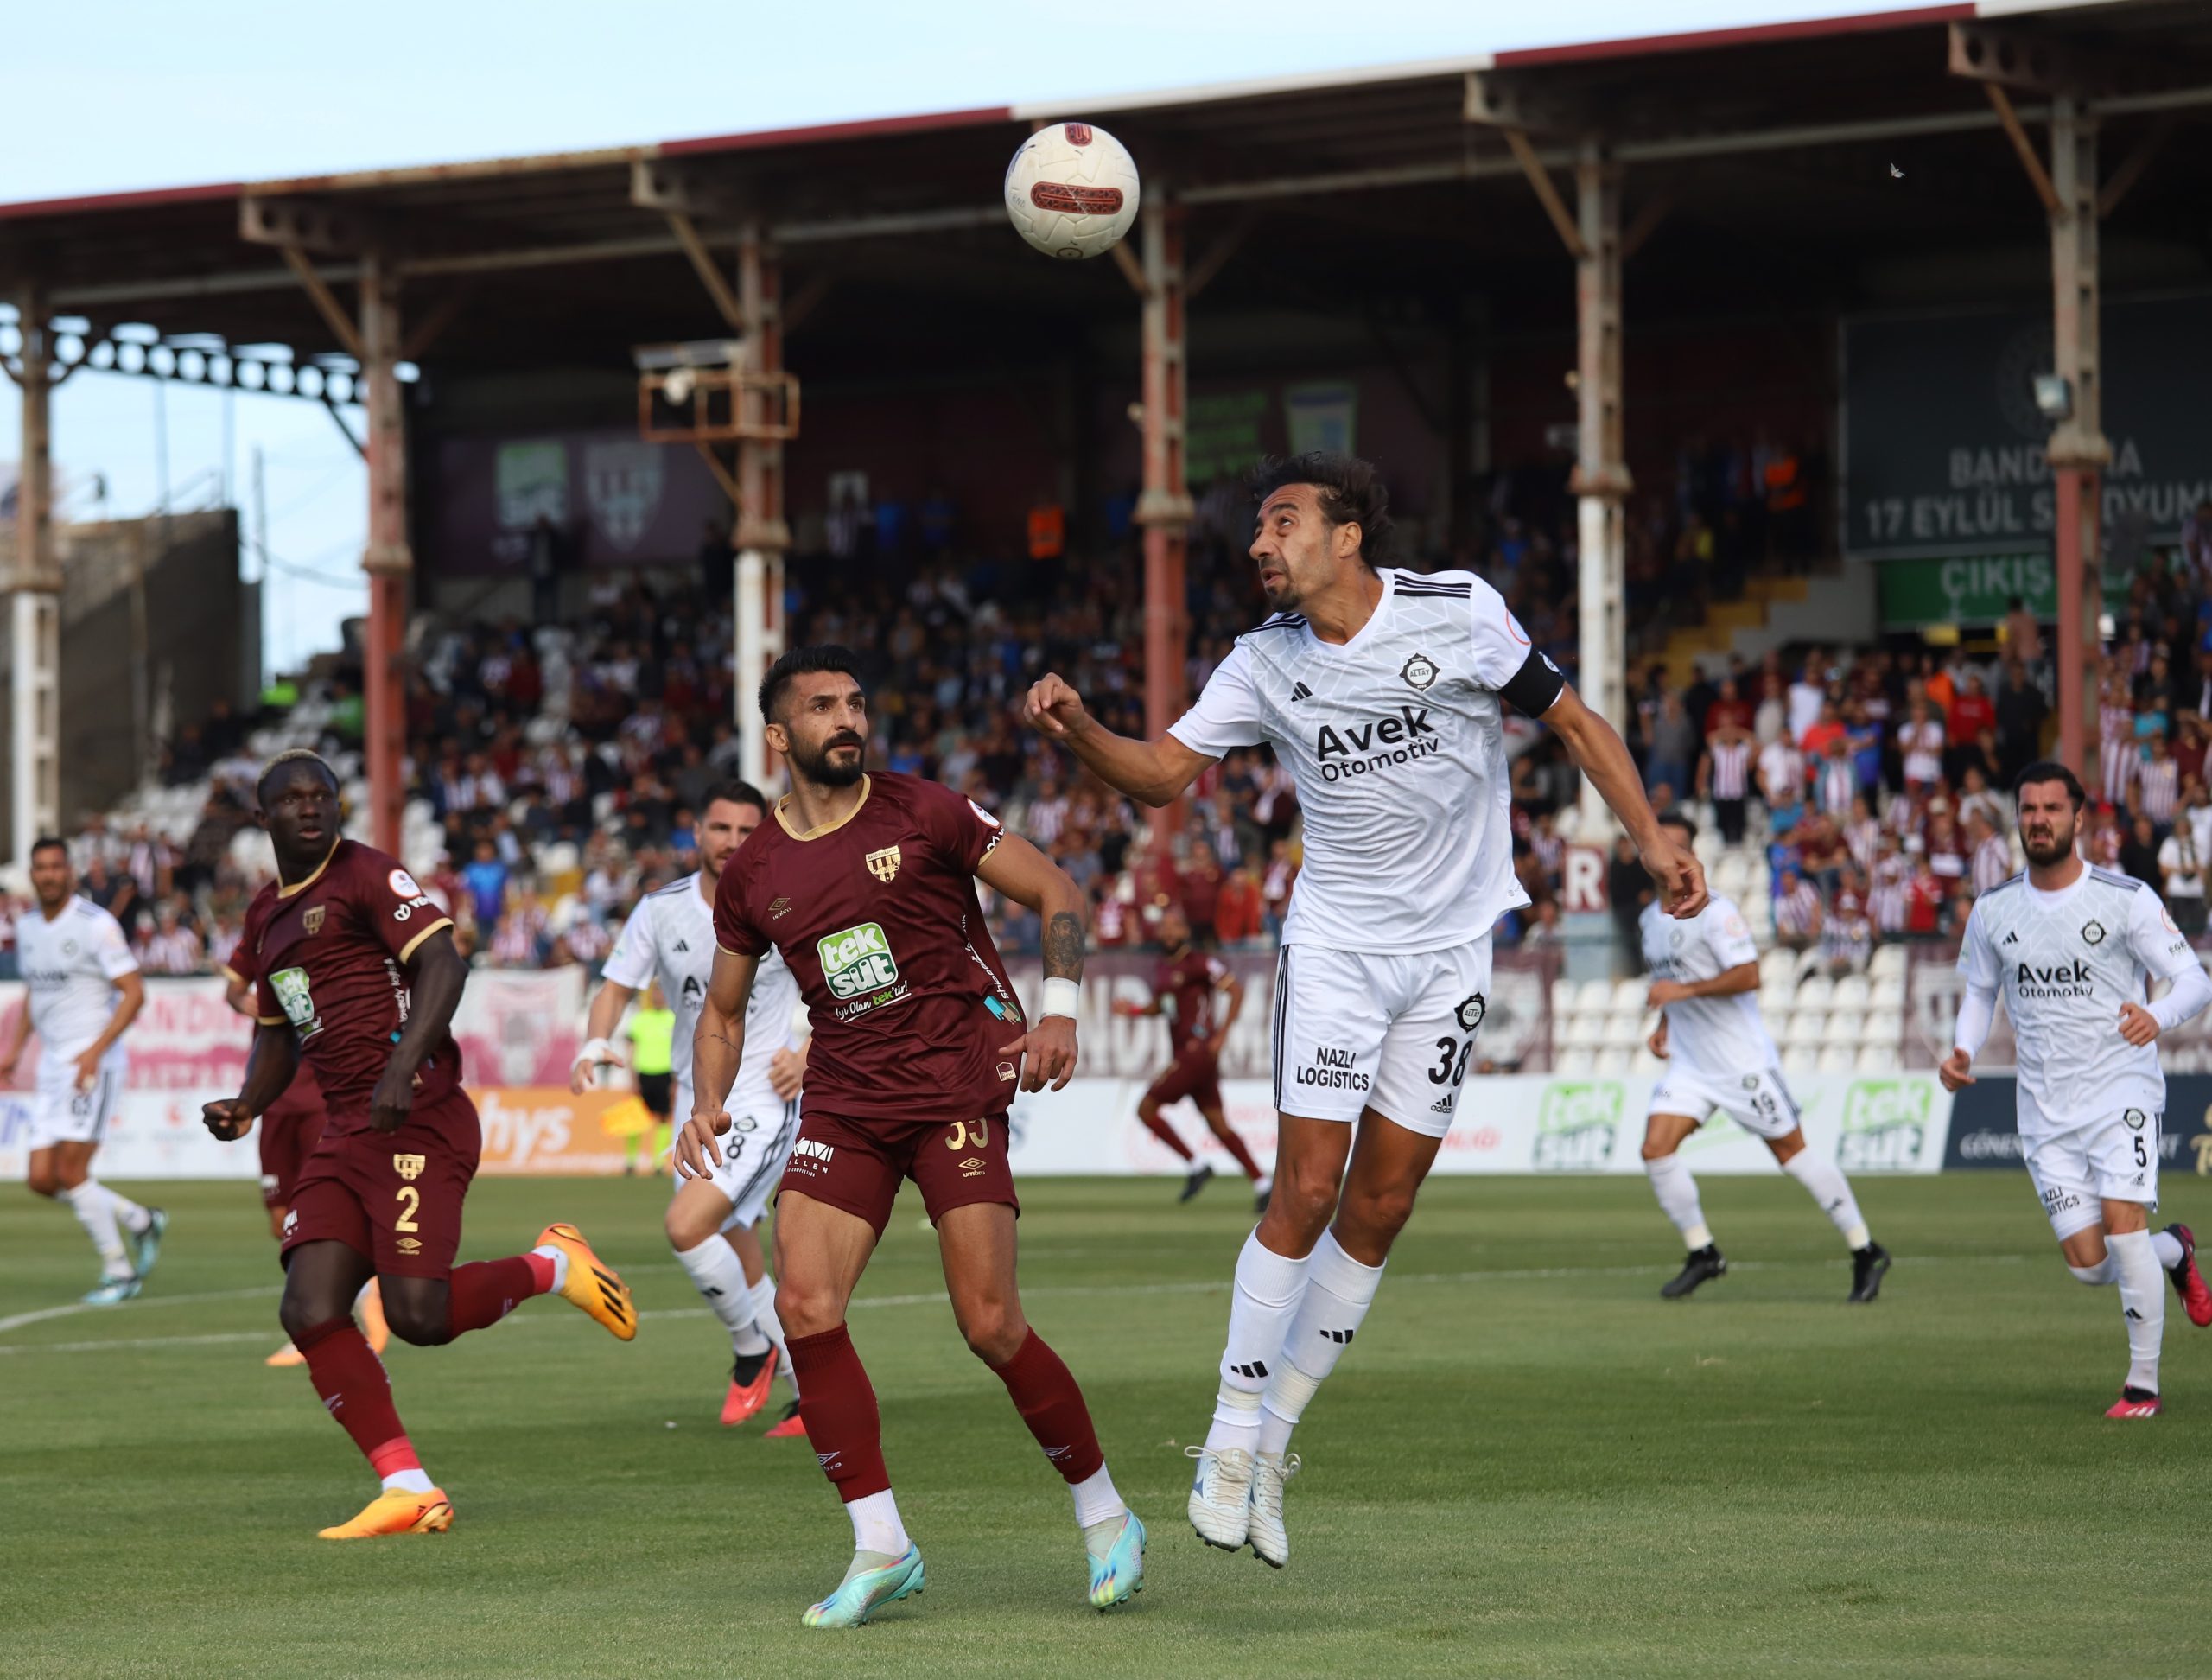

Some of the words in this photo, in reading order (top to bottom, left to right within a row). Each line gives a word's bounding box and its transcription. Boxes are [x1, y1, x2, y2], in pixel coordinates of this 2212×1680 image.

[1949, 438, 2143, 488] BANDA
[1866, 499, 1905, 540] 17
[1912, 491, 2024, 538] EYLÜL
[1940, 555, 2051, 601] ÇIKIŞ
[1410, 668, 1430, 678] ALTAY
[1317, 706, 1435, 762] Avek
[1321, 737, 1440, 782] Otomotiv
[1567, 849, 1606, 910] R
[823, 928, 884, 971] tek
[833, 955, 895, 996] süt
[2018, 960, 2093, 983] Avek
[2018, 984, 2094, 999] Otomotiv
[849, 1001, 872, 1014] Olan
[1296, 1066, 1370, 1091] LOGISTICS
[1316, 1047, 1357, 1069] NAZLI
[1428, 1036, 1473, 1087] 38
[727, 1136, 744, 1159] 8
[2134, 1136, 2147, 1167] 5
[963, 1169, 985, 1178] umbro
[396, 1186, 420, 1232] 2
